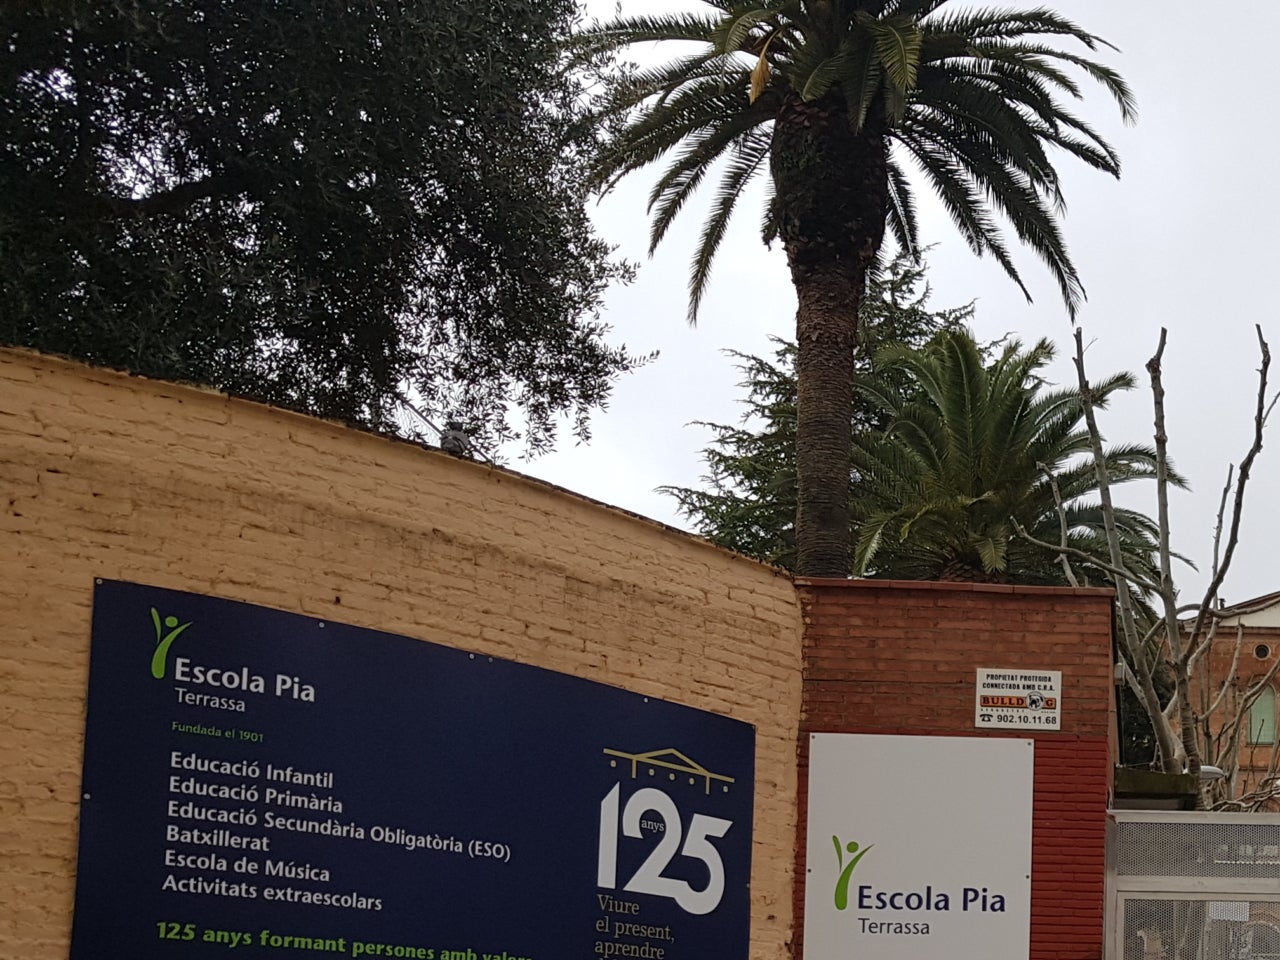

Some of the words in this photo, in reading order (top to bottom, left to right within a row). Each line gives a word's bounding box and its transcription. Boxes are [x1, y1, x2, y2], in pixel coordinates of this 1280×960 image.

[174, 657, 265, 693] Escola
[275, 674, 316, 702] Pia
[174, 688, 246, 713] Terrassa
[982, 697, 1053, 706] BULLDG
[172, 721, 222, 739] Fundada
[226, 730, 236, 740] el
[239, 730, 264, 743] 1901
[997, 714, 1057, 724] 902.10.11.68
[170, 751, 261, 778] Educació
[266, 763, 334, 789] Infantil
[169, 775, 259, 803] Educació
[265, 788, 343, 814] Primària
[166, 824, 270, 852] Batxillerat
[167, 800, 258, 827] Educació
[264, 812, 365, 840] Secundària
[370, 826, 463, 853] Obligatòria
[468, 839, 511, 863] (ESO)
[641, 818, 665, 832] anys
[597, 781, 734, 914] 125
[164, 850, 228, 872] Escola
[233, 857, 259, 874] de
[265, 861, 331, 883] Música
[162, 874, 258, 899] Activitats
[263, 884, 383, 911] extraescolars
[597, 894, 640, 915] Viure
[858, 885, 950, 911] Escola
[962, 887, 1006, 912] Pia
[595, 917, 609, 932] el
[614, 919, 675, 943] present,
[858, 918, 930, 935] Terrassa
[156, 921, 195, 941] 125
[202, 928, 253, 948] anys
[259, 931, 346, 953] formant
[352, 939, 435, 960] persones
[594, 939, 665, 960] aprendre
